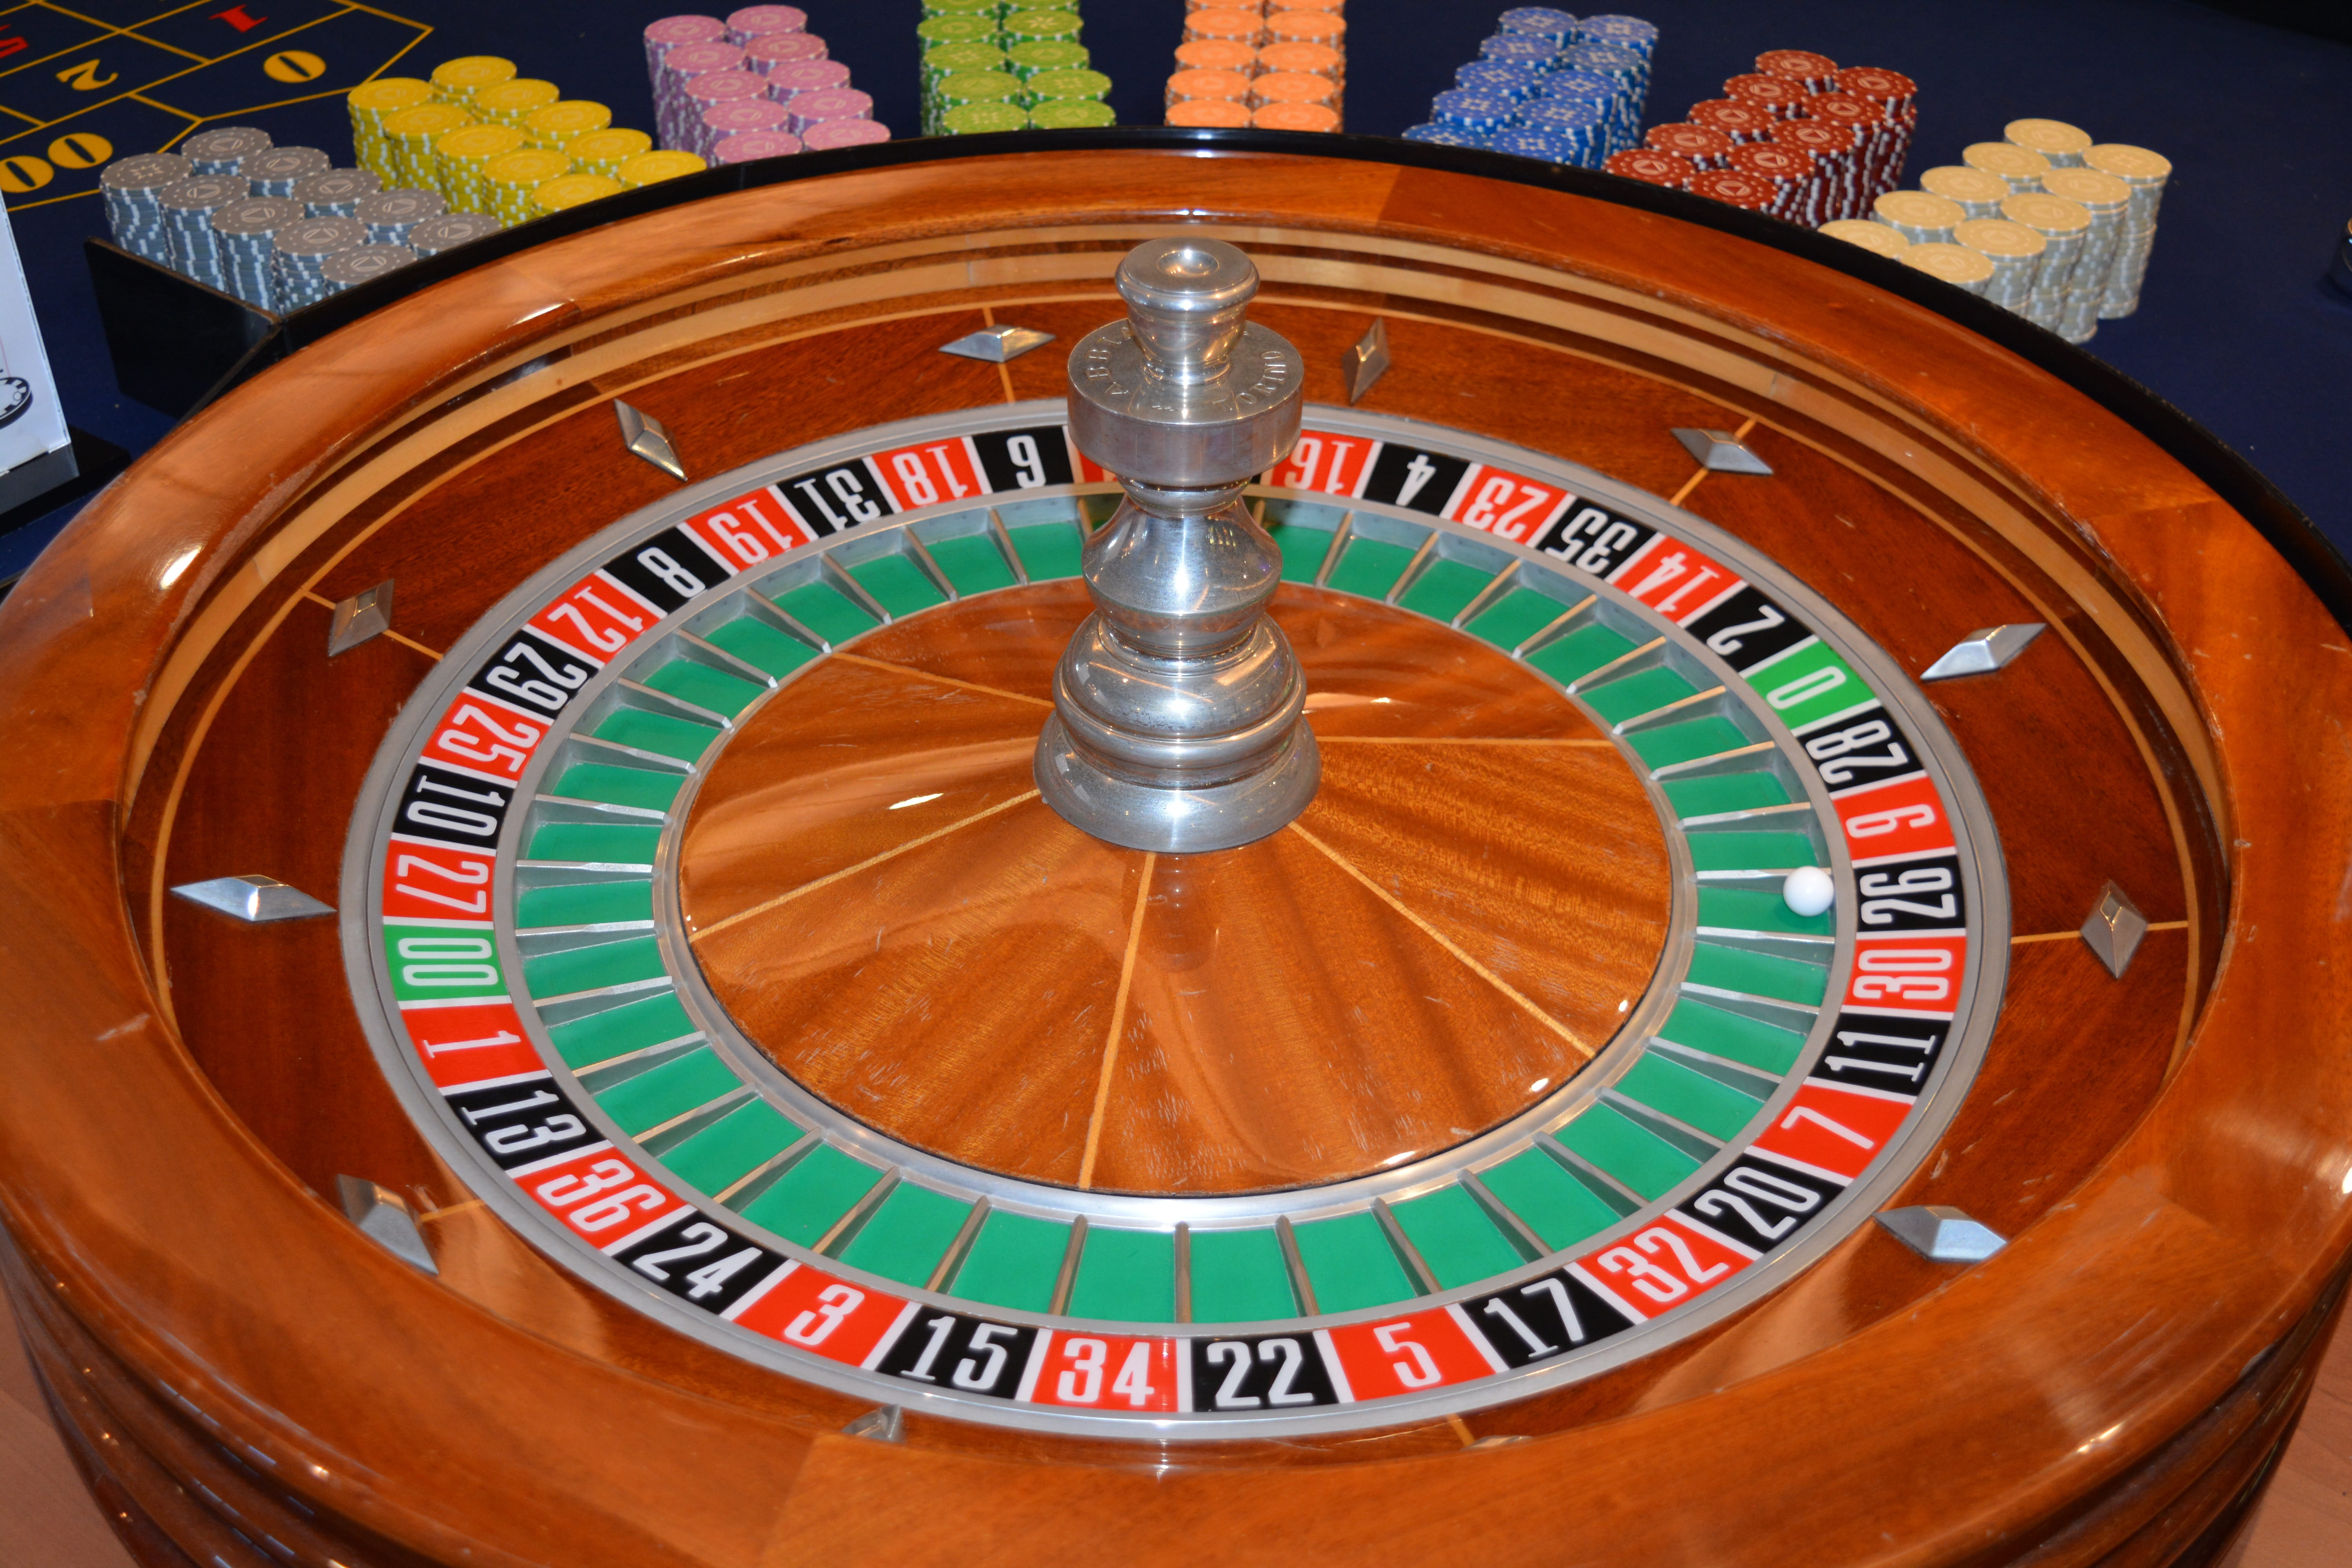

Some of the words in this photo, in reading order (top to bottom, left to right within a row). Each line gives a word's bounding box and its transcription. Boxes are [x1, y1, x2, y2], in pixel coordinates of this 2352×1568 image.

[209, 5, 268, 33] 1
[56, 58, 119, 91] 2
[264, 50, 327, 83] 0
[0, 132, 113, 193] 00
[892, 446, 968, 505] 18
[1284, 437, 1356, 495] 16
[1396, 453, 1436, 507] 4
[706, 499, 794, 559] 19
[795, 468, 881, 532] 31
[1462, 477, 1551, 541] 23
[1544, 508, 1637, 575] 35
[638, 547, 704, 600] 8
[1629, 552, 1719, 612] 14
[548, 586, 643, 652] 12
[1708, 604, 1785, 654] 2
[486, 642, 587, 710] 29
[1766, 666, 1847, 710] 0
[438, 704, 540, 772] 25
[1806, 720, 1908, 784] 28
[407, 775, 505, 836] 10
[396, 855, 488, 913] 27
[1860, 868, 1956, 924] 26
[398, 938, 498, 986] 00
[1853, 949, 1952, 1000] 30
[423, 1031, 521, 1058] 1
[1825, 1031, 1935, 1081] 11
[462, 1091, 586, 1153] 13
[1781, 1106, 1874, 1149] 7
[536, 1159, 666, 1232] 36
[1694, 1167, 1820, 1239] 20
[633, 1222, 762, 1298] 24
[1597, 1227, 1729, 1303] 32
[784, 1284, 864, 1346] 3
[1484, 1278, 1584, 1357] 17
[901, 1316, 1018, 1390] 15
[1057, 1338, 1155, 1407] 34
[1207, 1339, 1314, 1408] 22
[1374, 1322, 1442, 1388] 5
